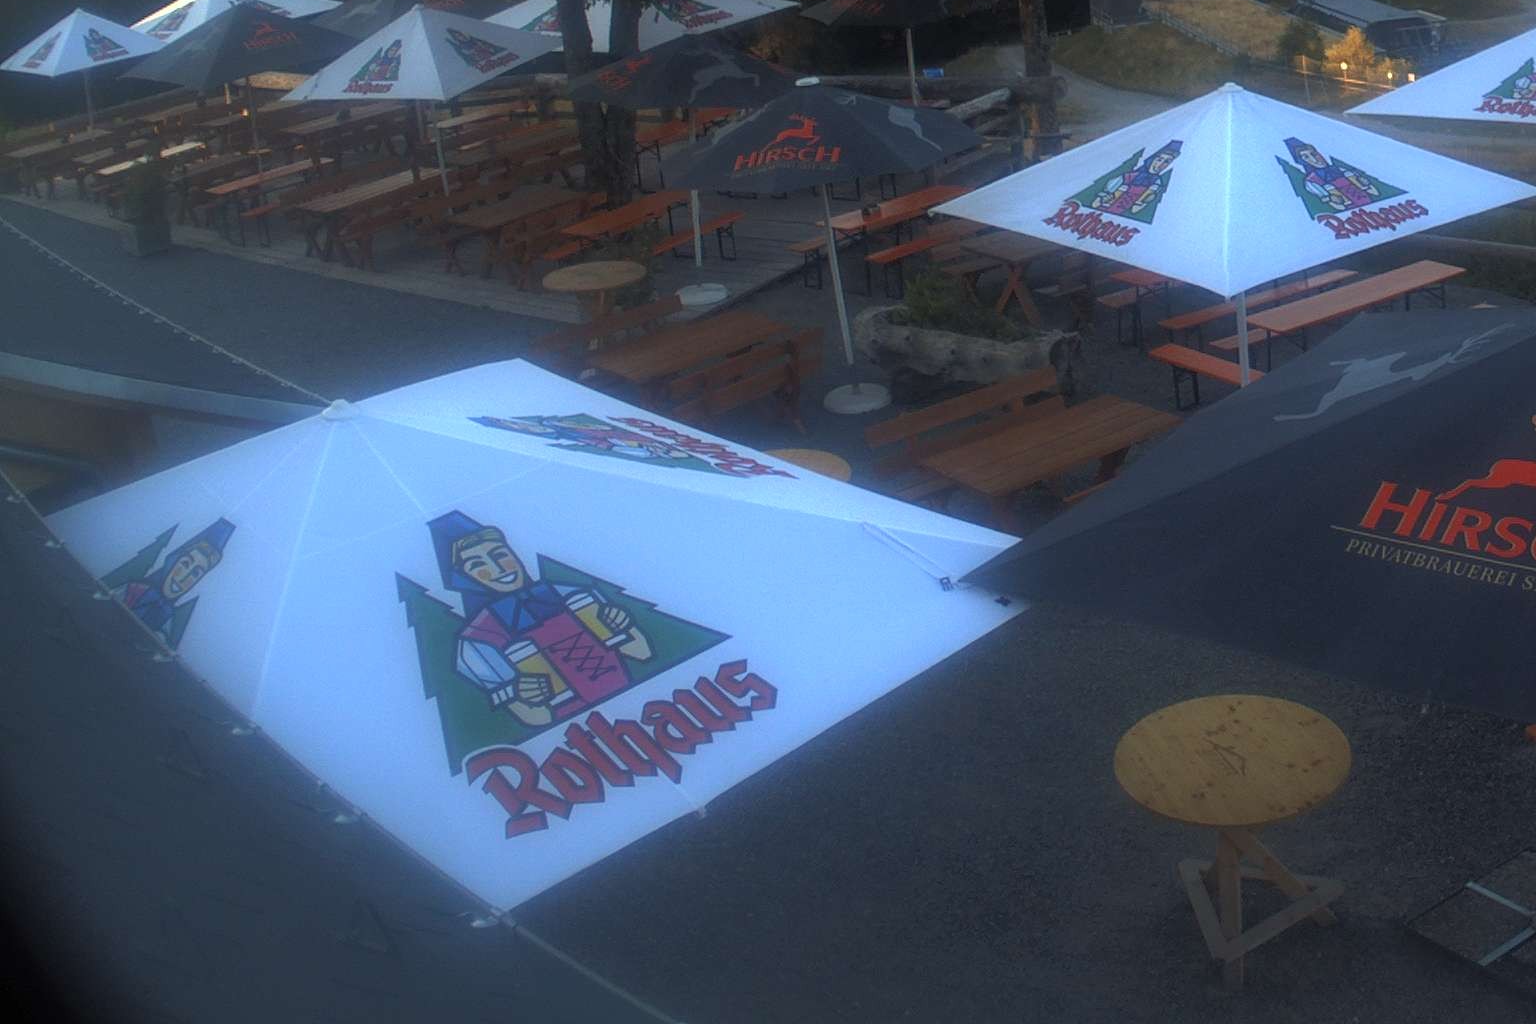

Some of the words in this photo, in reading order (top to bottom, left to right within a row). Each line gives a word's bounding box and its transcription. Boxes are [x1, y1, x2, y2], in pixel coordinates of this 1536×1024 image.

[734, 145, 841, 171] HIRSCH
[1042, 201, 1141, 247] Rothaus
[1317, 197, 1430, 240] Rothaus
[1345, 538, 1517, 587] PRIVATBRAUEREI
[462, 658, 778, 839] Rothaus
